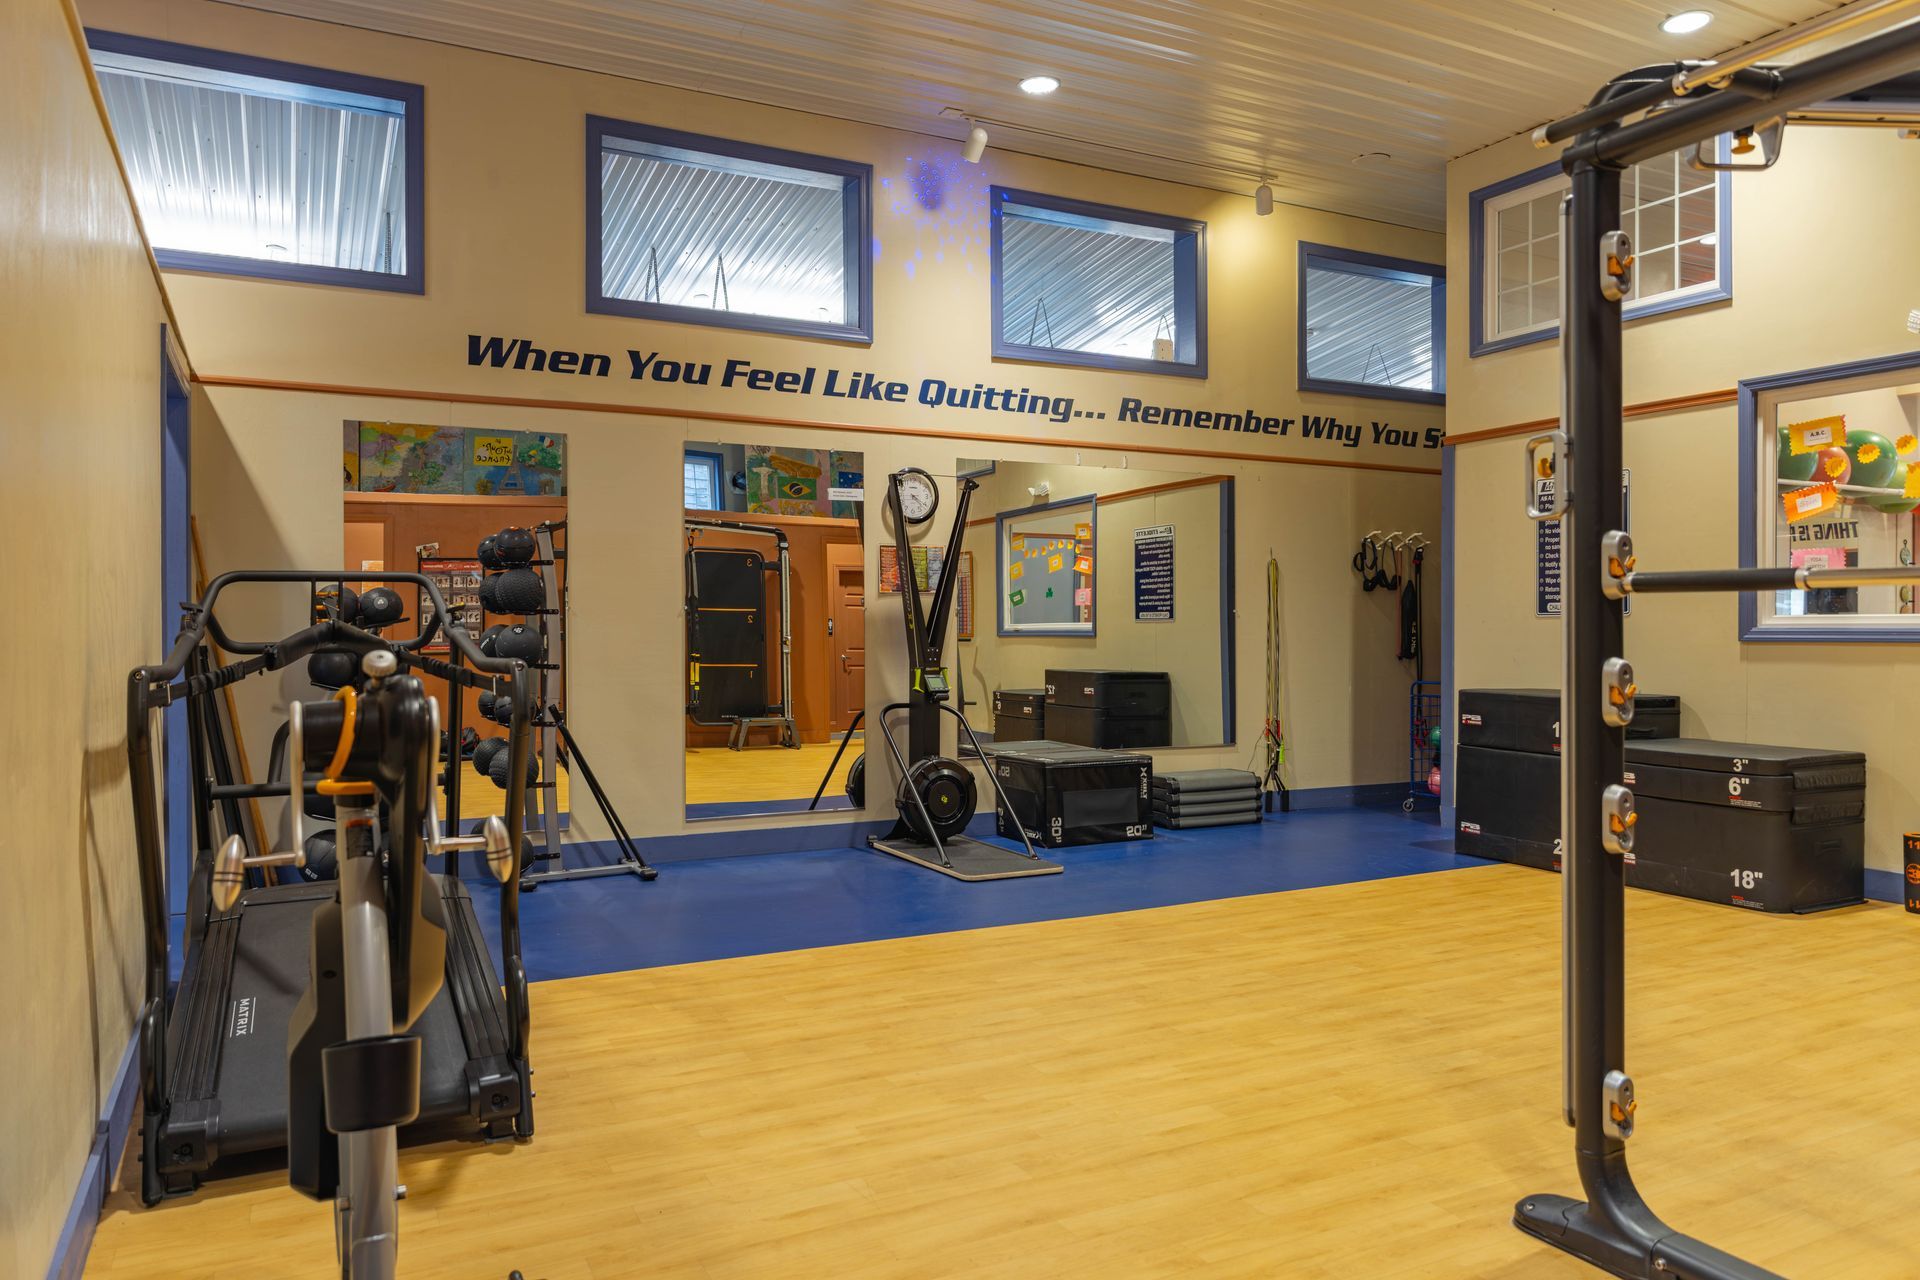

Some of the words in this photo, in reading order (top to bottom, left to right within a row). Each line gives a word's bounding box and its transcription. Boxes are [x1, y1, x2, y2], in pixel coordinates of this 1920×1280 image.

[467, 334, 612, 377] When
[626, 349, 712, 386] You
[720, 359, 817, 395] Feel
[822, 369, 909, 403] Like
[917, 378, 1106, 424] Quitting...
[1117, 397, 1295, 436] Remember
[1301, 415, 1362, 448] Why
[1371, 421, 1418, 448] You
[1733, 758, 1749, 772] 3"
[1728, 776, 1750, 796] 6"
[1126, 824, 1148, 837] 20"
[1730, 868, 1764, 890] 18"
[235, 997, 251, 1037] MATRIX
